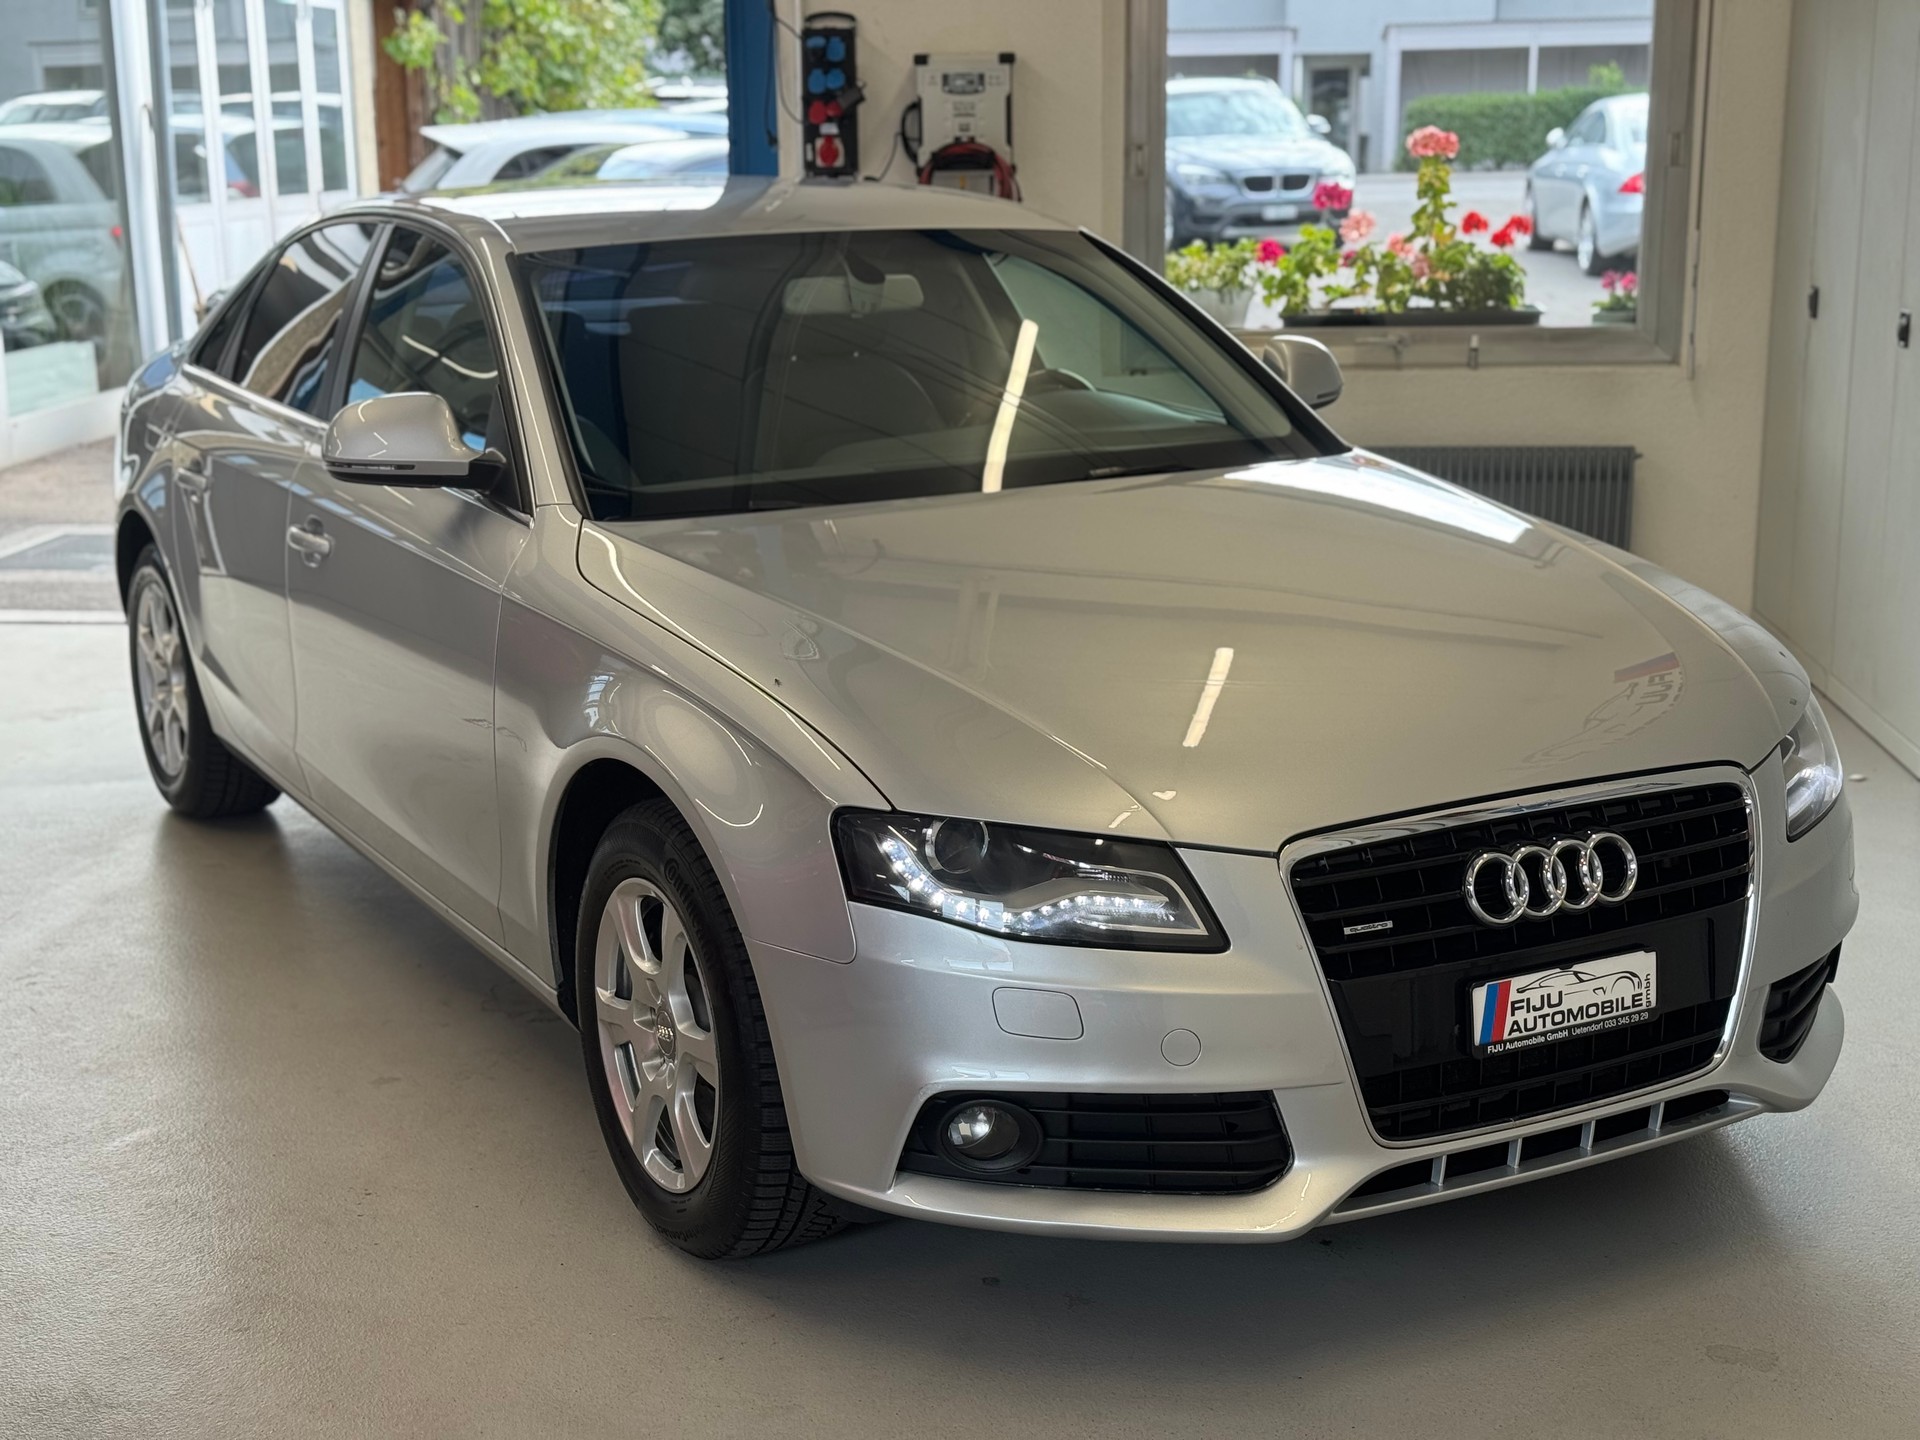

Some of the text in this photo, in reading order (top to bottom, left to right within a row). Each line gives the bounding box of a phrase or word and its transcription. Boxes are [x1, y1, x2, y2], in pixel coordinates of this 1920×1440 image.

[1348, 921, 1389, 933] quattro
[1507, 992, 1644, 1036] AUTOMOBILE
[1510, 991, 1563, 1017] FIJU
[1487, 1011, 1649, 1054] FIJU Automobile GmbH Uetendorf 033 345 29 29
